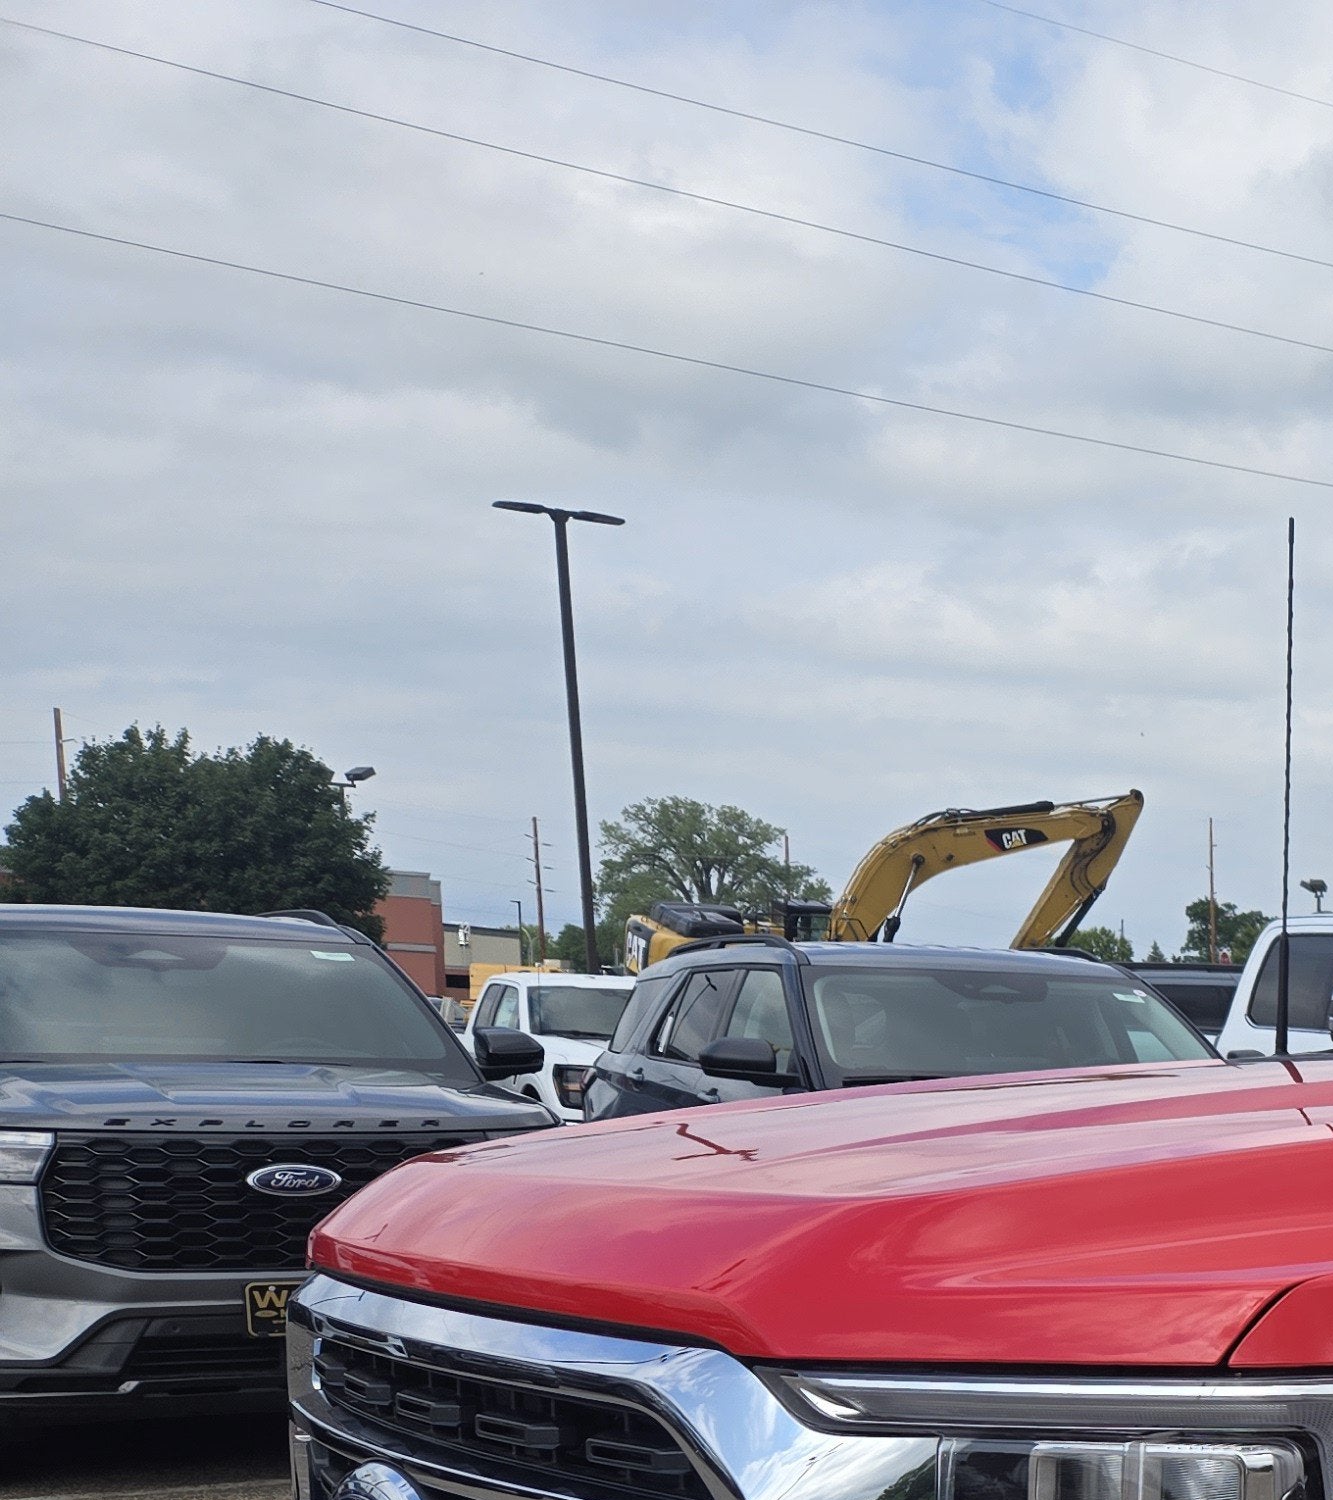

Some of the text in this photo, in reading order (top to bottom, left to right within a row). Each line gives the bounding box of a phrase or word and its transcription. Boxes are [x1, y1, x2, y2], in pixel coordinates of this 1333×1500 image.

[1002, 829, 1028, 850] CAT
[627, 930, 647, 970] CAT
[103, 1118, 440, 1128] EXPLORER
[270, 1171, 322, 1190] Ford
